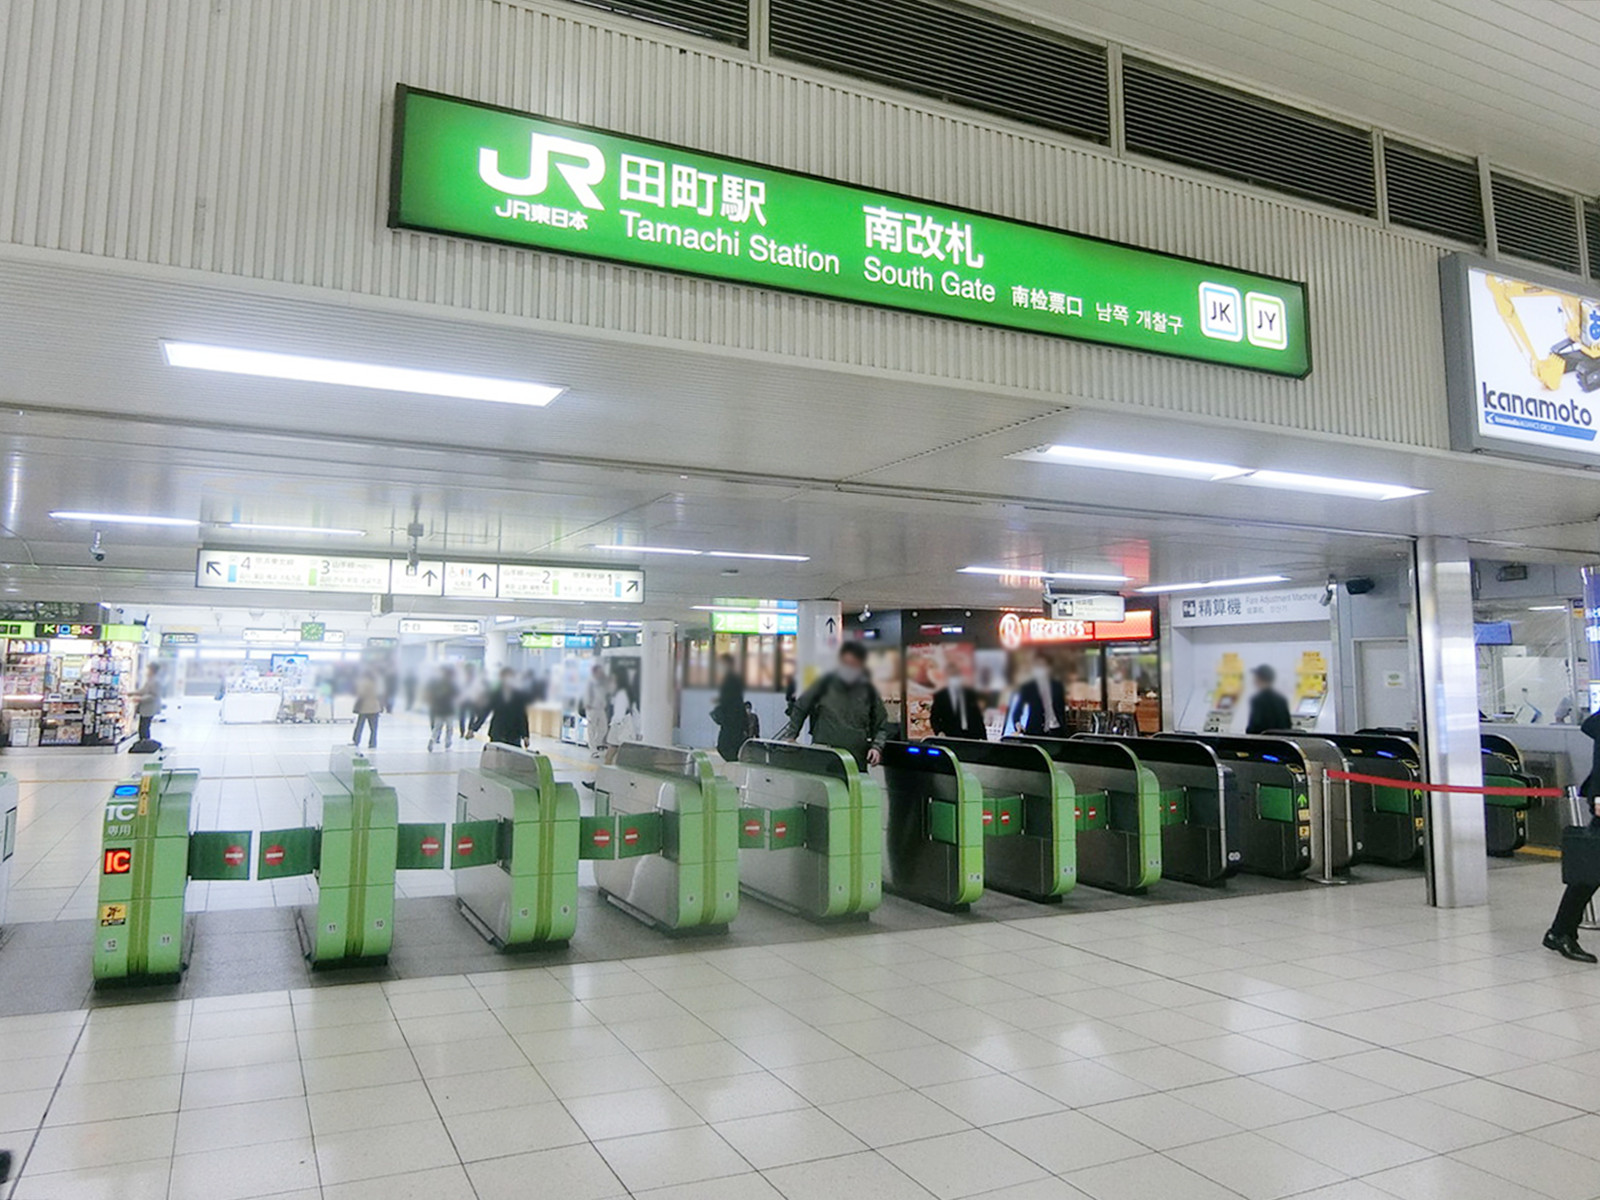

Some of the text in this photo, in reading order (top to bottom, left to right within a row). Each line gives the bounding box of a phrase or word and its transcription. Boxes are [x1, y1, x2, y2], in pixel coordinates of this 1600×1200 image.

[478, 132, 606, 211] JR
[619, 153, 767, 227] 田町駅
[495, 199, 588, 231] JR東日本
[620, 210, 840, 275] Tamachi Station
[862, 204, 985, 269] 南改札
[863, 256, 996, 303] South Gate
[1011, 284, 1083, 317] 南检票口
[1210, 299, 1277, 332] JK JY
[1095, 302, 1184, 336] 남쪽 개찰구
[1482, 382, 1592, 426] kanamoto
[240, 556, 251, 570] 4
[320, 560, 331, 575] 3
[541, 570, 551, 584] 2
[607, 573, 613, 586] 1
[715, 613, 725, 631] 2
[1198, 598, 1242, 617] 精算機
[44, 624, 94, 635] KIOSK
[106, 804, 136, 821] IC
[105, 852, 131, 872] IC
